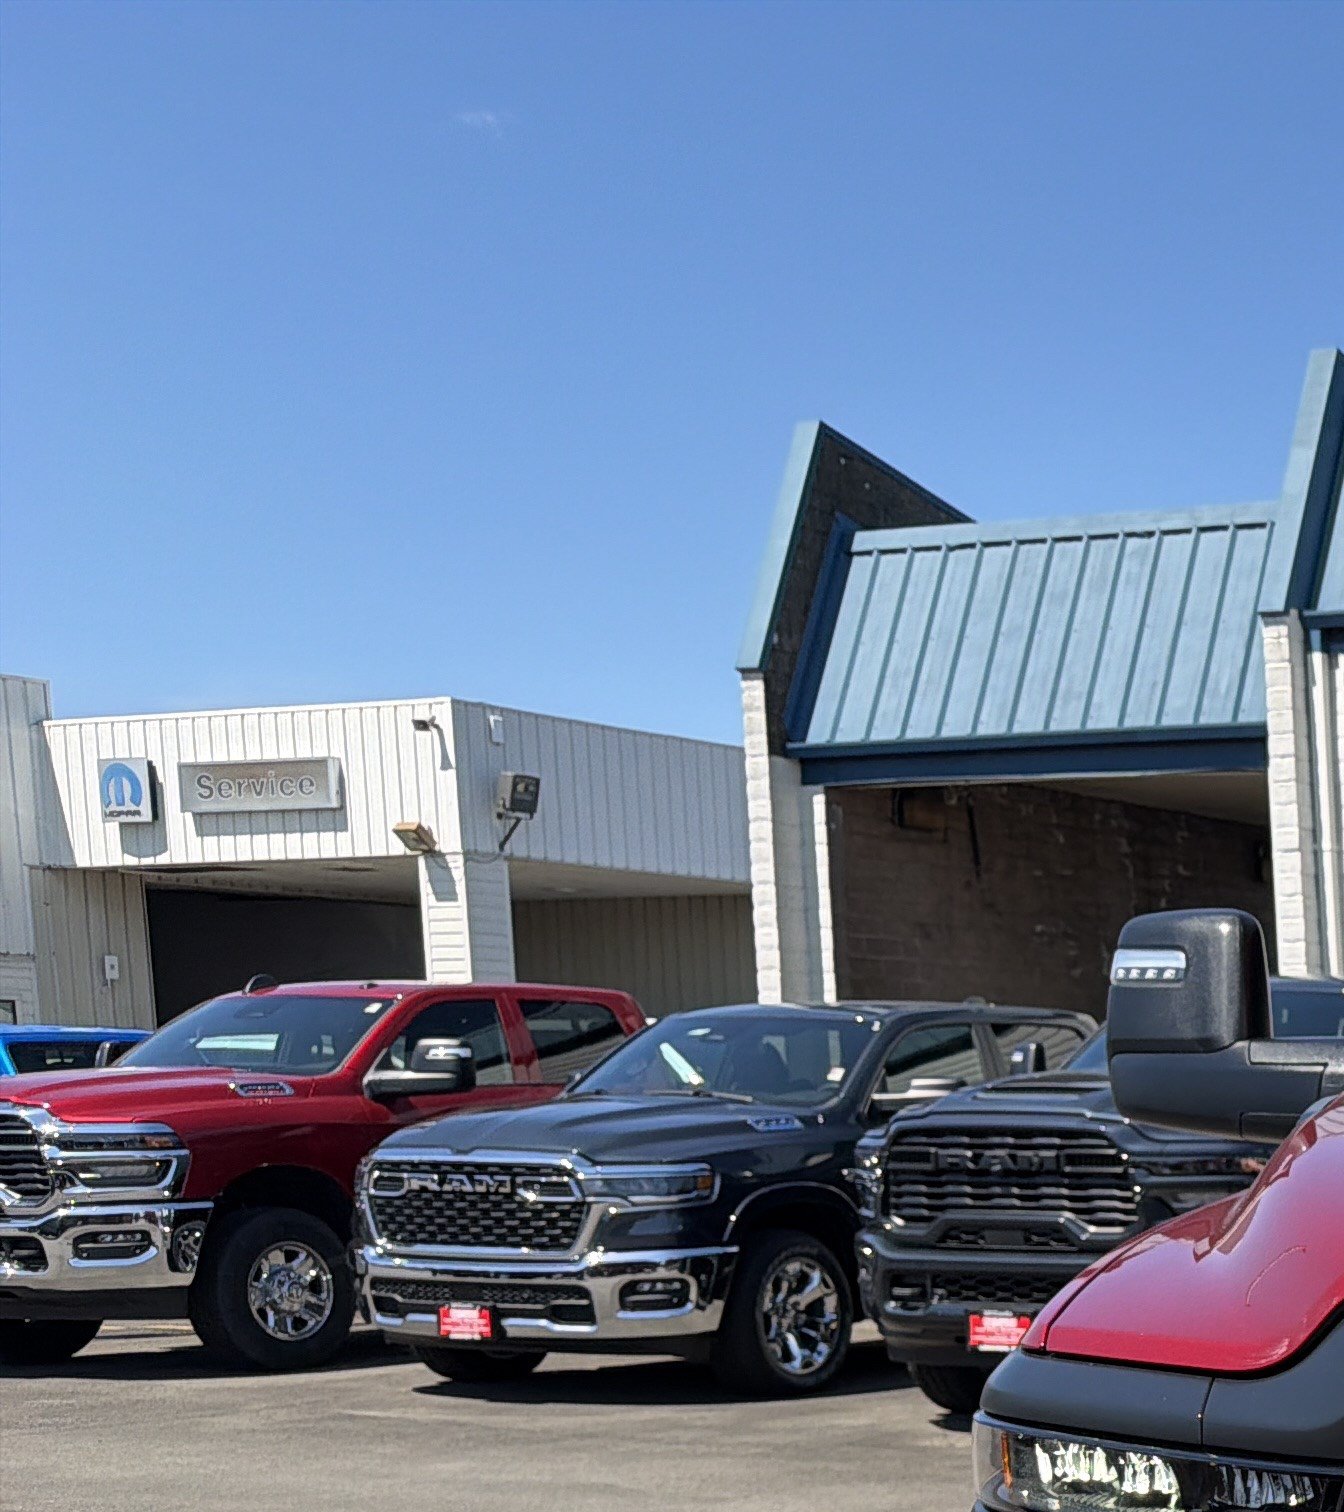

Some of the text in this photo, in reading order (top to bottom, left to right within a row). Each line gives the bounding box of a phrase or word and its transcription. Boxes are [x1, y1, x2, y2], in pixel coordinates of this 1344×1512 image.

[196, 770, 317, 801] Service
[937, 1148, 1058, 1171] RAM
[409, 1173, 512, 1194] RAM
